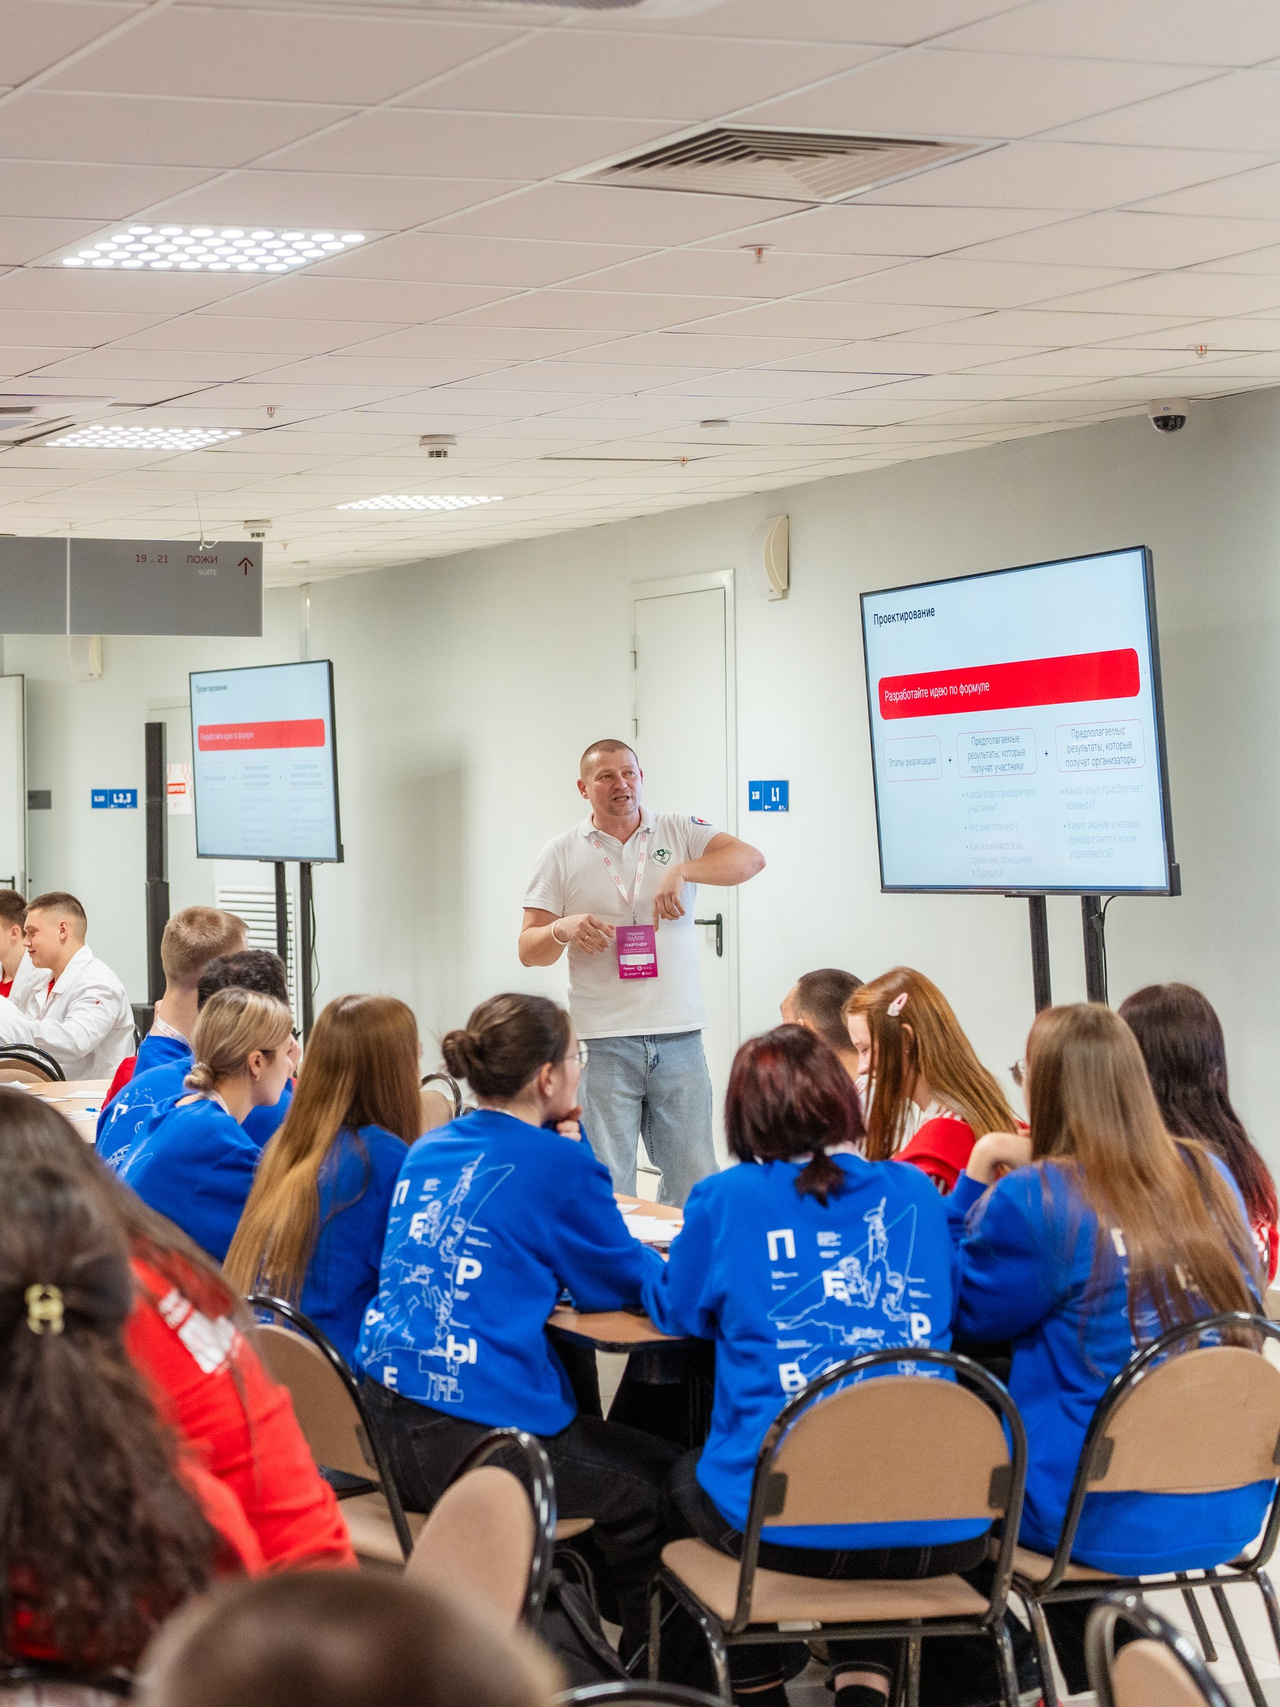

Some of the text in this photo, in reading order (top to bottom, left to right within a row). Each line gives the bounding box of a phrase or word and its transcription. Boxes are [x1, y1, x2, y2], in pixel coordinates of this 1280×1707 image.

[135, 554, 218, 564] 19 21 ЛОЖИ
[873, 606, 935, 627] Проектирование
[884, 681, 990, 704] Разработайте идею по формуле
[1071, 726, 1126, 740] Предполагаемые
[971, 735, 1020, 748] Предполагаемые
[1066, 741, 1133, 755] результаты, которые
[888, 755, 937, 769] Этапы реализации
[967, 748, 1026, 762] результаты, которые
[970, 762, 1024, 775] получат участники
[1065, 755, 1137, 770] получат организаторы
[771, 787, 780, 802] L1
[1064, 783, 1143, 797] Какой опыт приобретает
[1065, 799, 1096, 811] команда?
[1067, 820, 1086, 830] Какие
